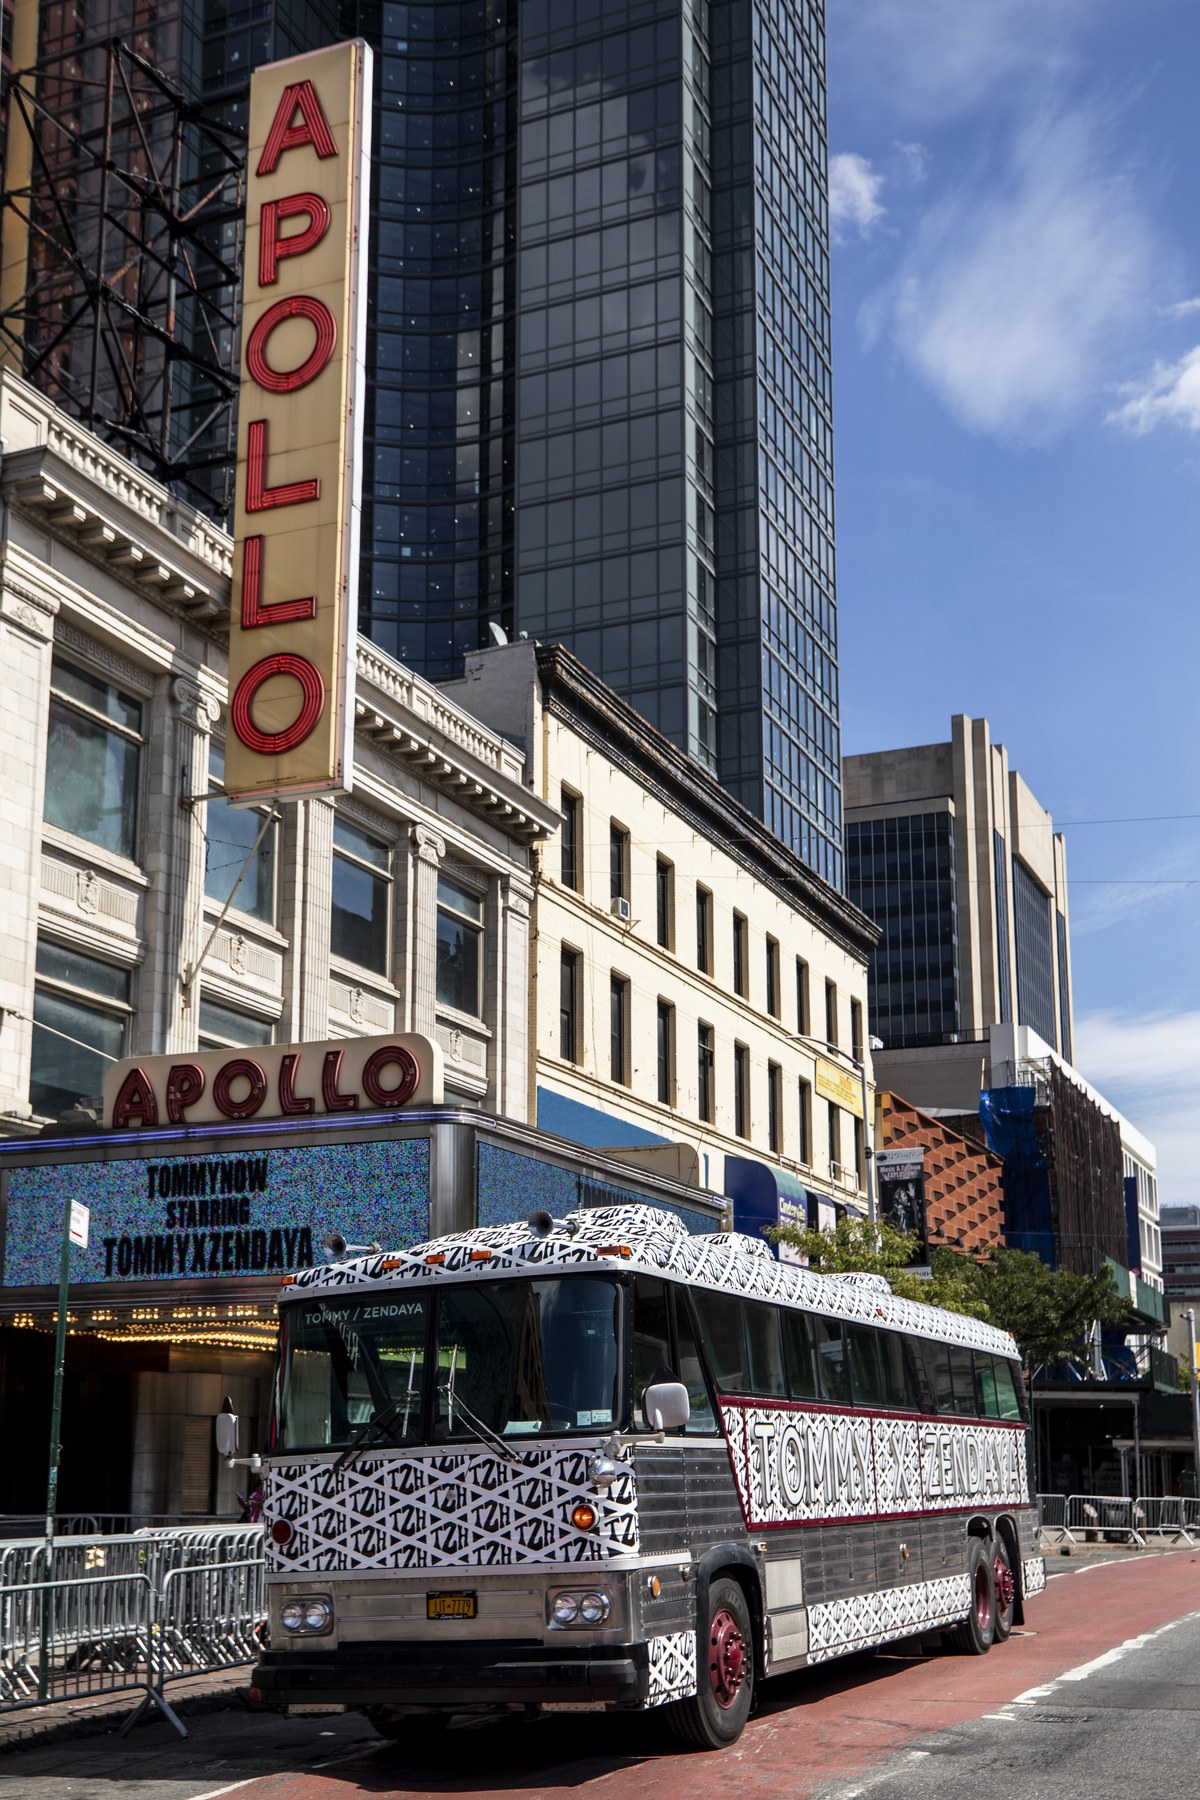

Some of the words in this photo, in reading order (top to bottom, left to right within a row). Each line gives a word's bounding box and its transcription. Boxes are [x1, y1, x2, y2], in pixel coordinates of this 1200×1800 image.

[232, 79, 339, 755] APOLLO
[112, 1045, 420, 1128] APOLLO
[147, 1158, 269, 1199] TOMMYNOW
[166, 1198, 250, 1228] STARRING
[104, 1227, 313, 1276] TOMMYXZENDAYA
[517, 1241, 556, 1263] TZH
[305, 1309, 350, 1325] TOMMY
[363, 1302, 423, 1319] ZENDAYA
[310, 1468, 345, 1499] TZH
[387, 1463, 426, 1495] TZH
[468, 1458, 508, 1490] TZH
[750, 1422, 872, 1507] TOMMY
[890, 1429, 912, 1499] X
[924, 1431, 1021, 1498] ZENDAYA
[275, 1490, 309, 1521] TZH
[349, 1486, 386, 1518] TZH
[429, 1482, 467, 1514] TZH
[513, 1477, 553, 1510] TZH
[312, 1508, 347, 1540] TZH
[389, 1504, 426, 1537] TZH
[471, 1500, 511, 1533] TZH
[350, 1525, 386, 1558] TZH
[431, 1521, 469, 1555] TZH
[515, 1517, 555, 1551] TZH
[313, 1547, 347, 1571] TZH
[390, 1544, 427, 1568] TZH
[473, 1540, 512, 1565] TZH
[559, 1536, 603, 1562] TZH
